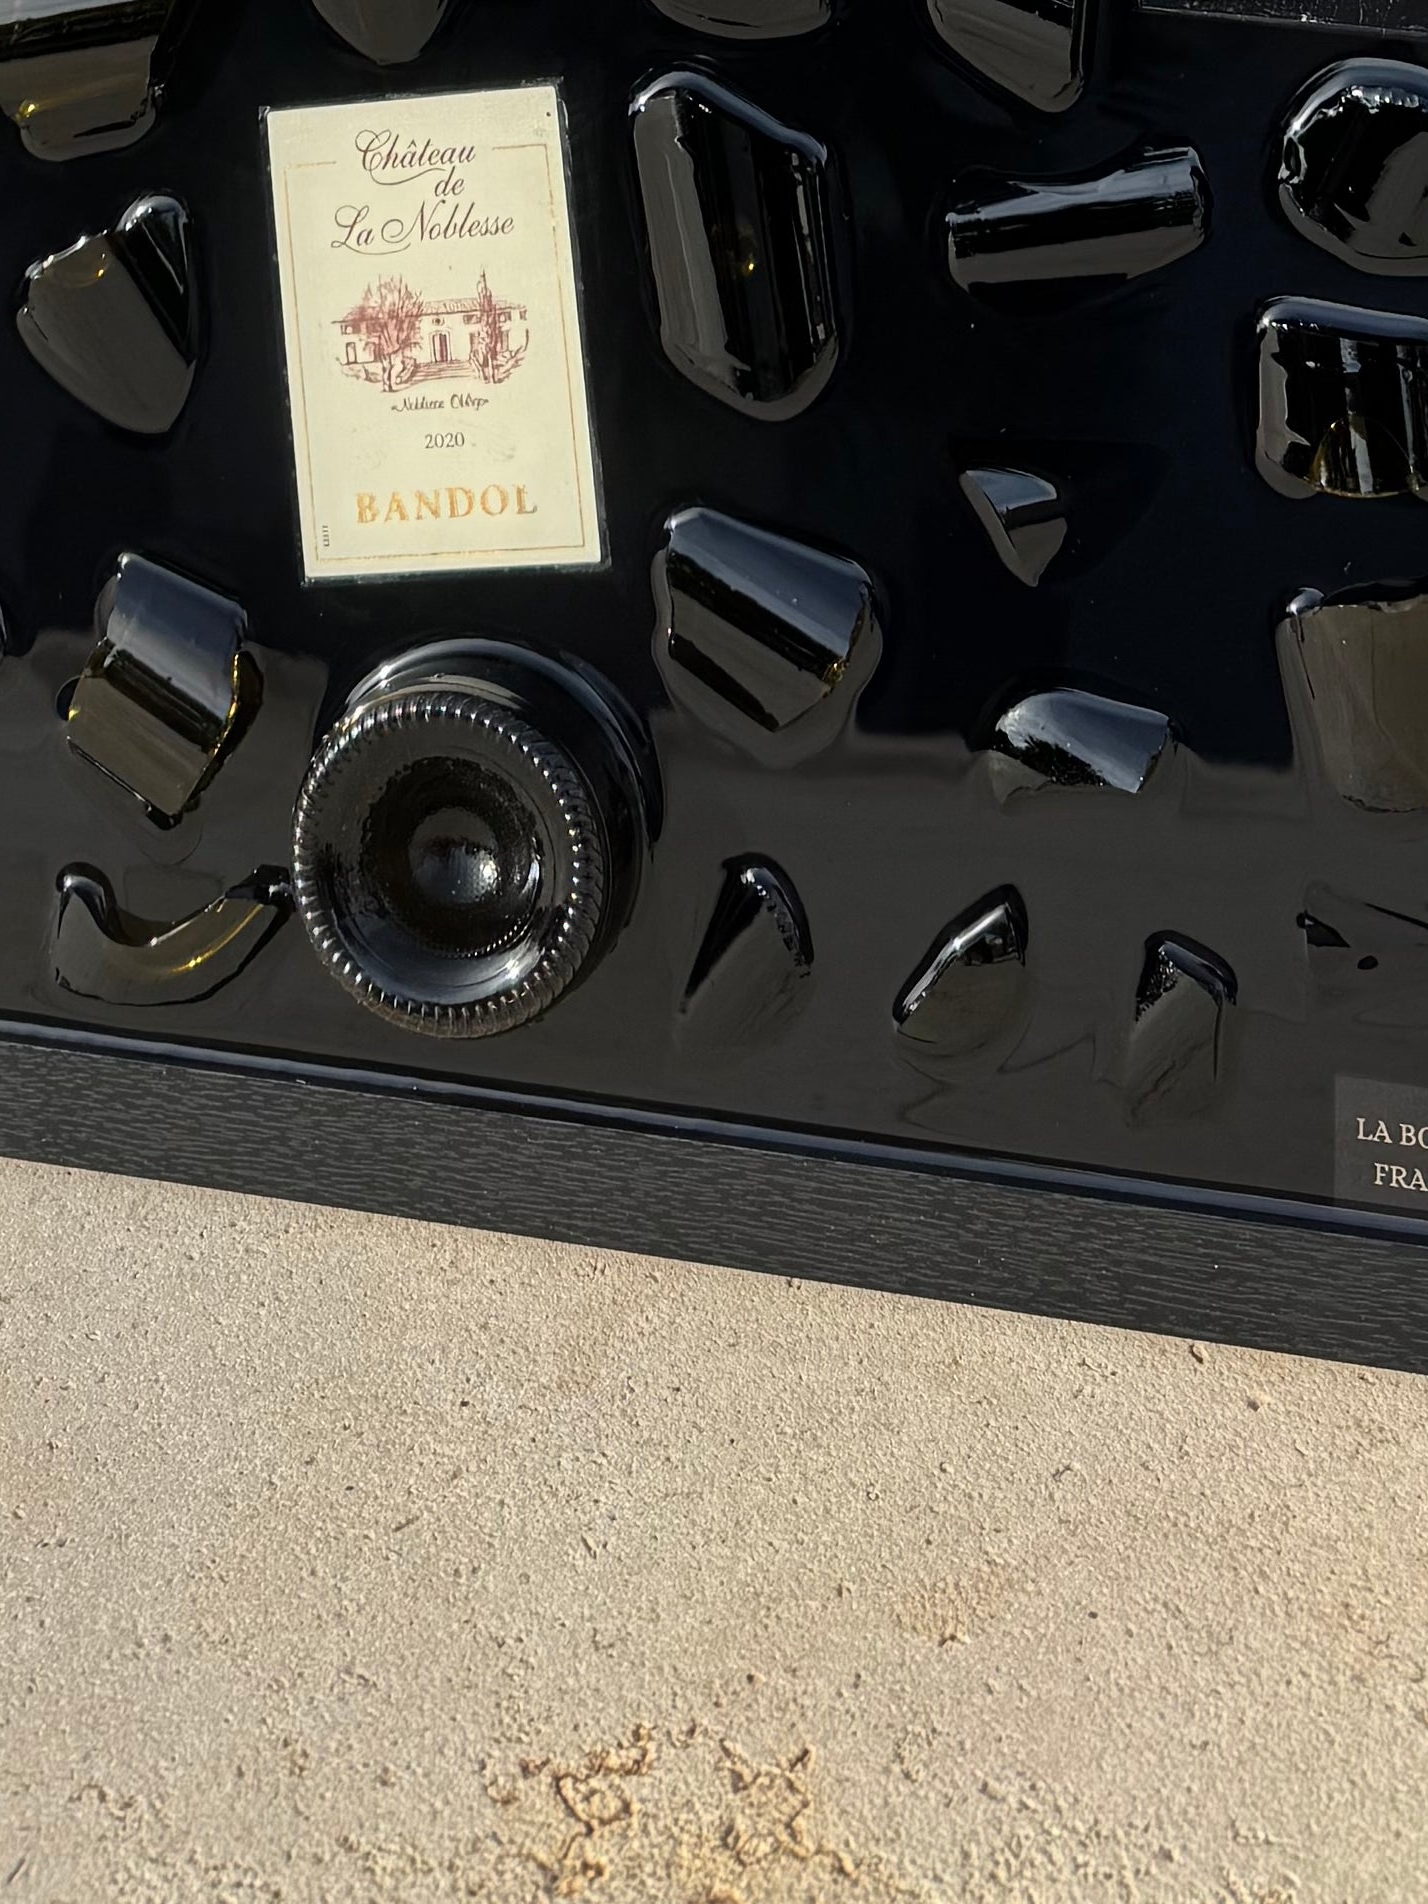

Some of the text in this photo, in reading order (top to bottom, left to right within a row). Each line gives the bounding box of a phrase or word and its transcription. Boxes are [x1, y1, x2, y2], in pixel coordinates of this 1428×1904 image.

[355, 128, 476, 185] Château
[434, 165, 465, 197] de
[383, 199, 514, 245] Noblesse
[425, 432, 465, 449] 2020
[356, 484, 538, 523] BANDOL
[1357, 1117, 1393, 1144] LA
